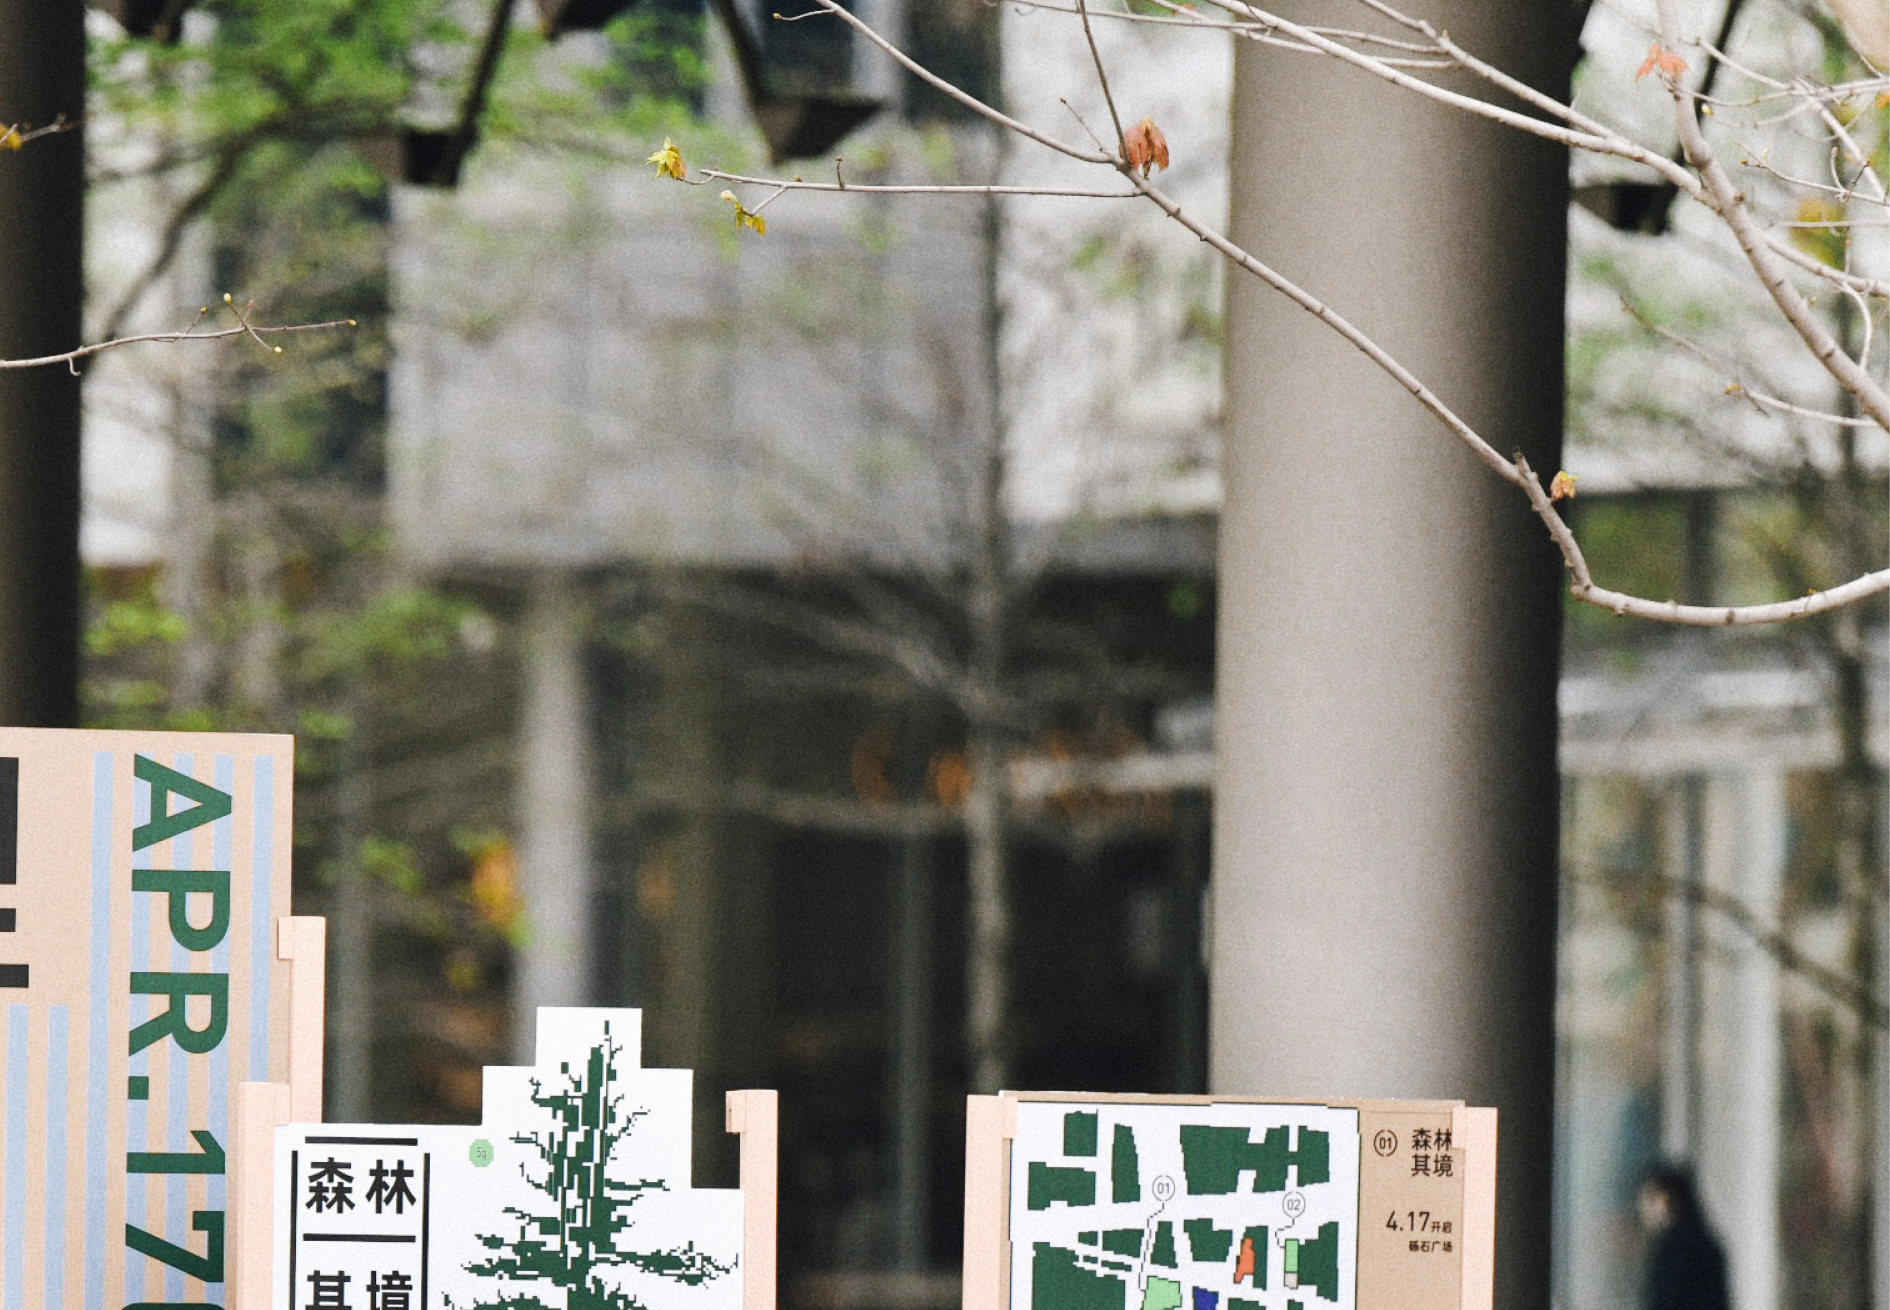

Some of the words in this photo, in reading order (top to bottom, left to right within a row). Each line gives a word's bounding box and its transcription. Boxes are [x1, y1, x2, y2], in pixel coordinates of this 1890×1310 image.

[1379, 1137, 1392, 1150] 01
[1411, 1127, 1452, 1151] 森林
[476, 1145, 488, 1162] 5g
[1411, 1154, 1453, 1177] 其境
[306, 1157, 416, 1214] 森林
[1156, 1181, 1170, 1194] 01
[1286, 1198, 1302, 1211] 02
